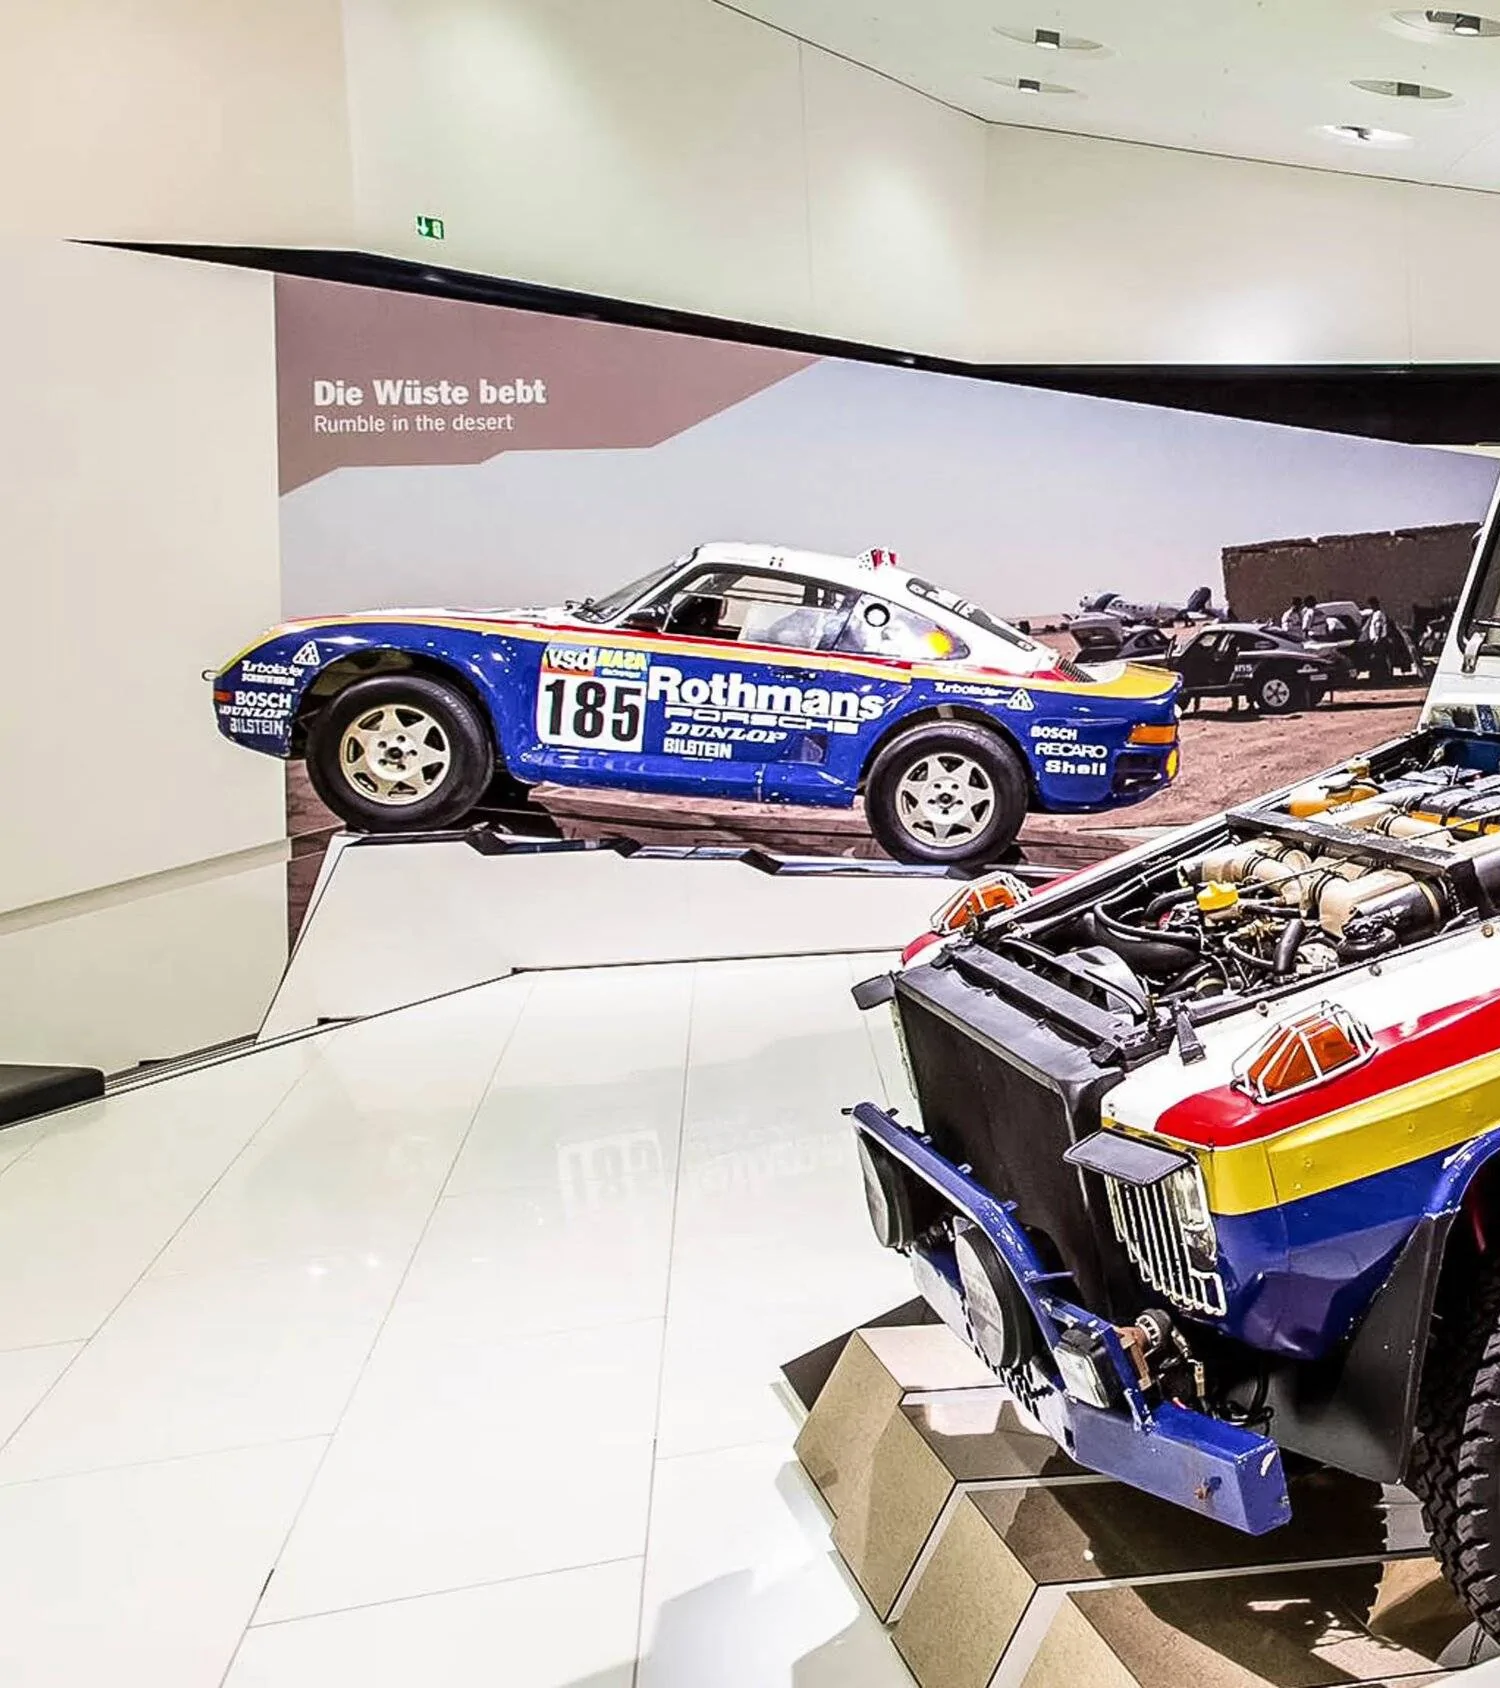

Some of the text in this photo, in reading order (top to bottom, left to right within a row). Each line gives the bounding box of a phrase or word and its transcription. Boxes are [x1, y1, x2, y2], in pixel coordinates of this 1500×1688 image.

[313, 379, 547, 406] Die Wüste bebt
[314, 413, 515, 433] Rumble in the desert
[234, 691, 292, 709] BOSCH
[648, 666, 887, 721] Rothmans
[219, 705, 290, 719] DUNLOP
[545, 679, 642, 742] 185
[229, 718, 284, 736] BILSTEIN
[666, 722, 787, 744] DUNLOP
[1030, 725, 1078, 741] BOSCH
[663, 737, 733, 760] BILSTEIN
[1034, 742, 1108, 758] RECARO
[1045, 759, 1107, 776] Shell
